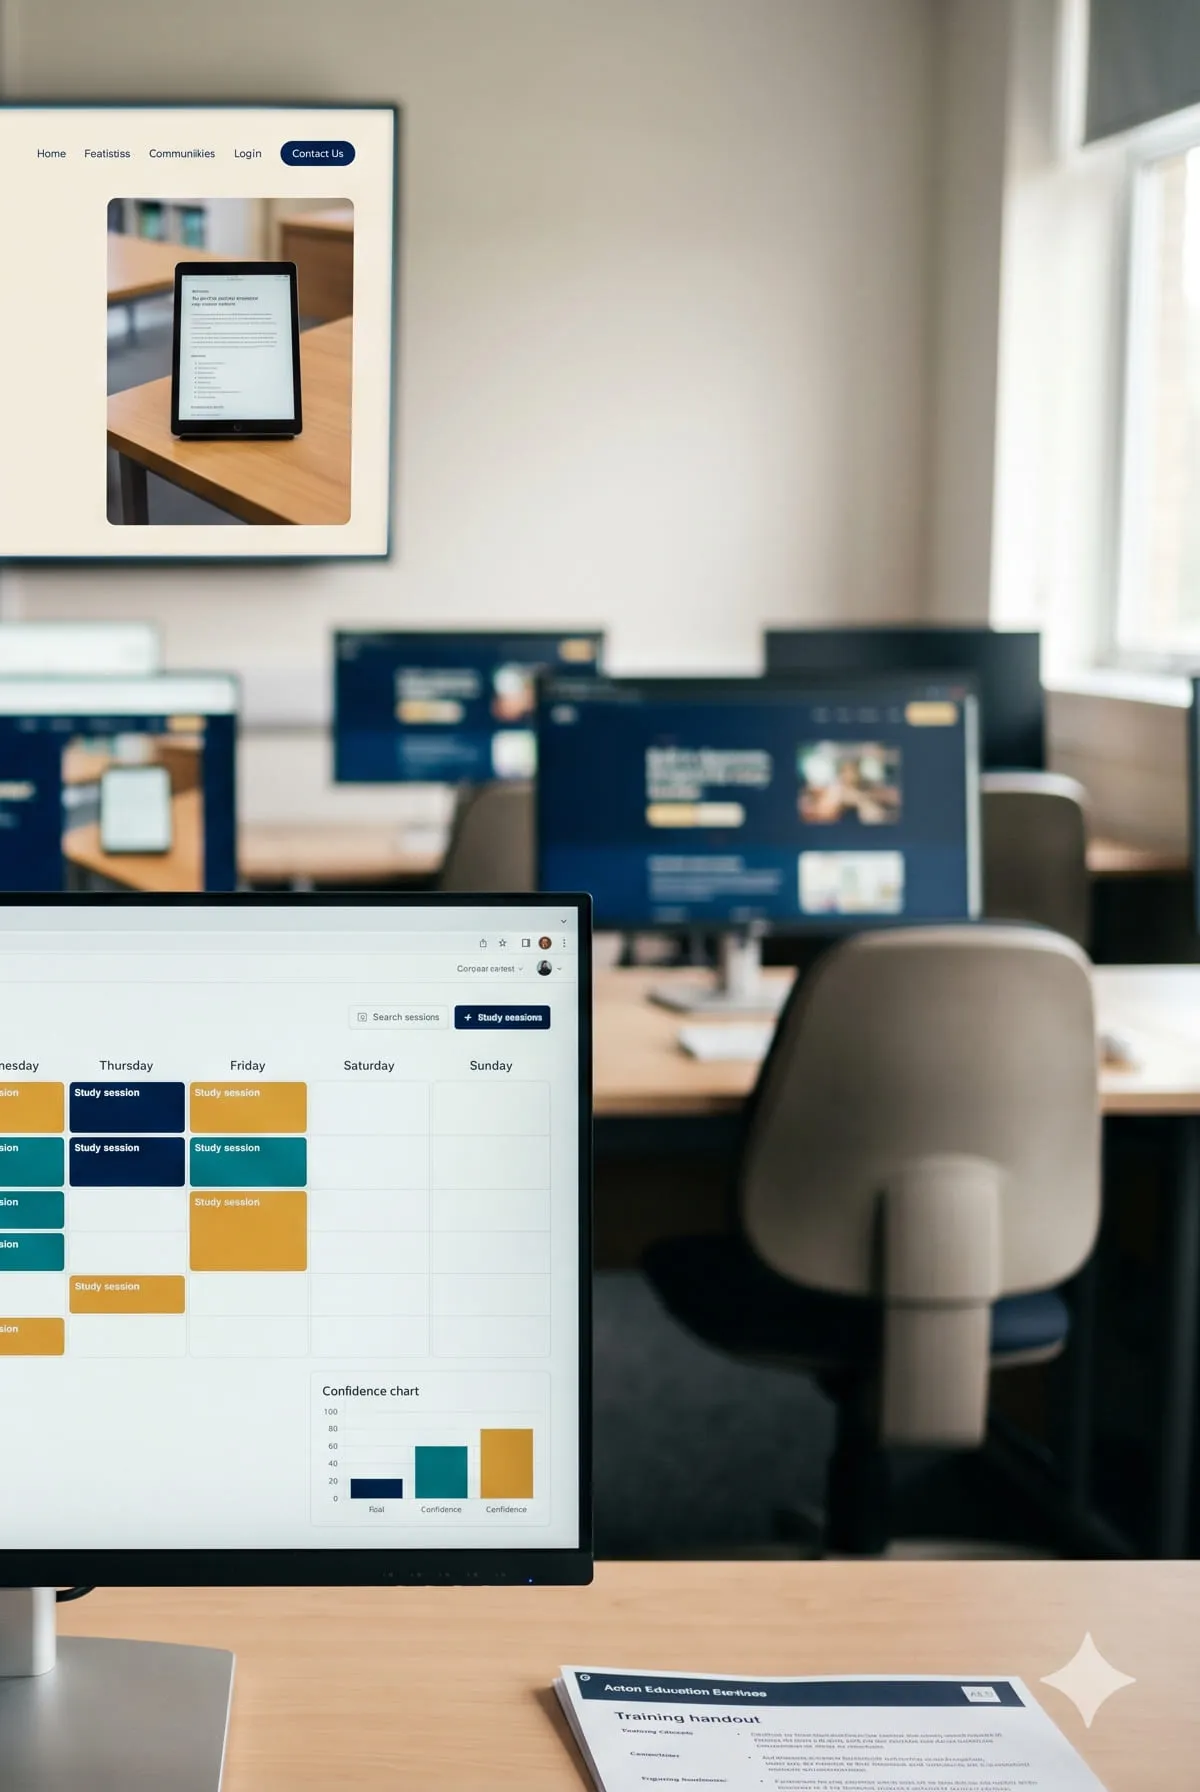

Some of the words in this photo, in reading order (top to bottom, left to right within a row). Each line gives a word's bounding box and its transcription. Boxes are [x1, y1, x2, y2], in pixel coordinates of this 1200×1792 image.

[38, 149, 66, 158] Home
[235, 149, 261, 159] Login
[293, 149, 329, 158] Contact
[332, 149, 344, 157] Us
[373, 1013, 402, 1021] Search
[405, 1013, 439, 1021] sessions
[478, 1014, 502, 1023] Study
[99, 1060, 153, 1072] Thursday
[231, 1060, 265, 1072] Friday
[344, 1060, 394, 1072] Saturday
[470, 1060, 512, 1072] Sunday
[75, 1089, 101, 1098] Study
[104, 1088, 139, 1096] session
[195, 1088, 221, 1098] Study
[75, 1144, 101, 1153] Study
[195, 1144, 221, 1153] Study
[224, 1144, 260, 1152] session
[195, 1198, 221, 1208] Study
[224, 1198, 260, 1206] session
[75, 1282, 101, 1292] Study
[104, 1282, 140, 1290] session
[323, 1386, 386, 1396] Confidence
[390, 1386, 419, 1396] chart
[615, 1712, 684, 1723] Training
[689, 1715, 760, 1723] handout
